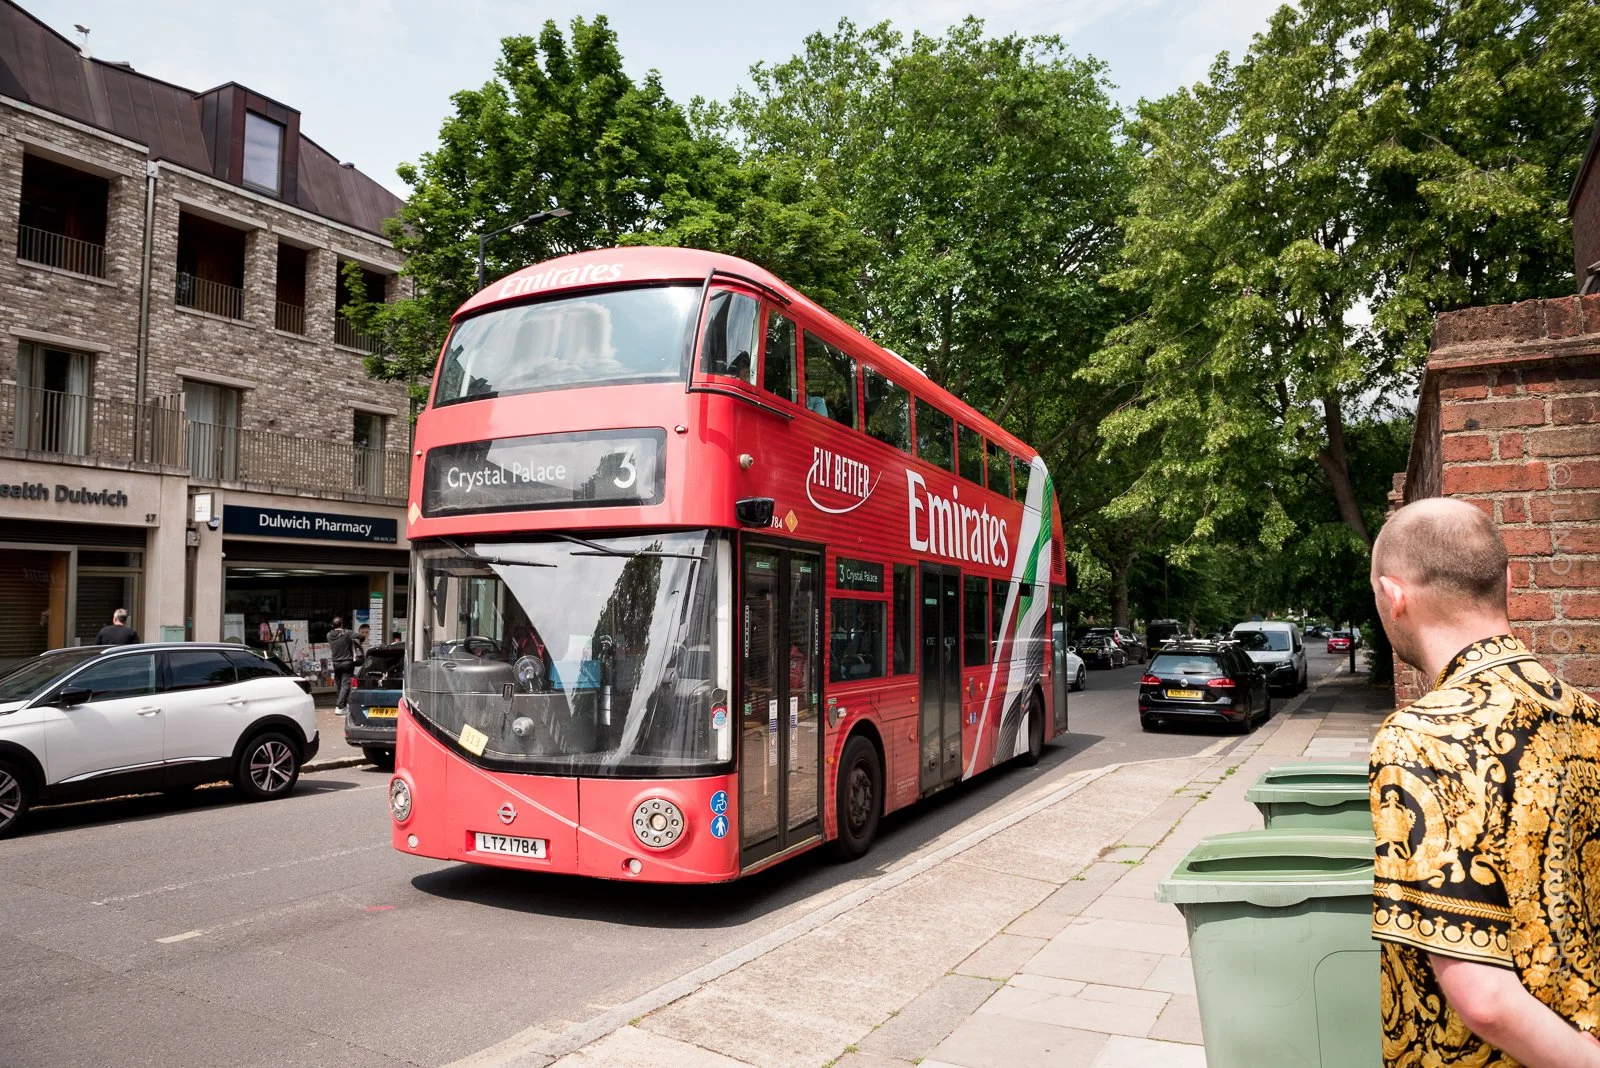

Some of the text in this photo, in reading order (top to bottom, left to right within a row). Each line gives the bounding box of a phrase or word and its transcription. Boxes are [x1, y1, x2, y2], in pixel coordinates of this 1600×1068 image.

[499, 263, 624, 298] Emirates
[447, 461, 566, 493] Crystal Palace
[613, 446, 637, 490] 3
[813, 446, 871, 498] FLY BETTER
[55, 484, 128, 507] Dulwich
[145, 513, 157, 523] 17
[259, 513, 372, 536] Dulwich Pharmacy
[905, 468, 1009, 569] Emirates
[839, 564, 878, 583] 3 Crystal Palace
